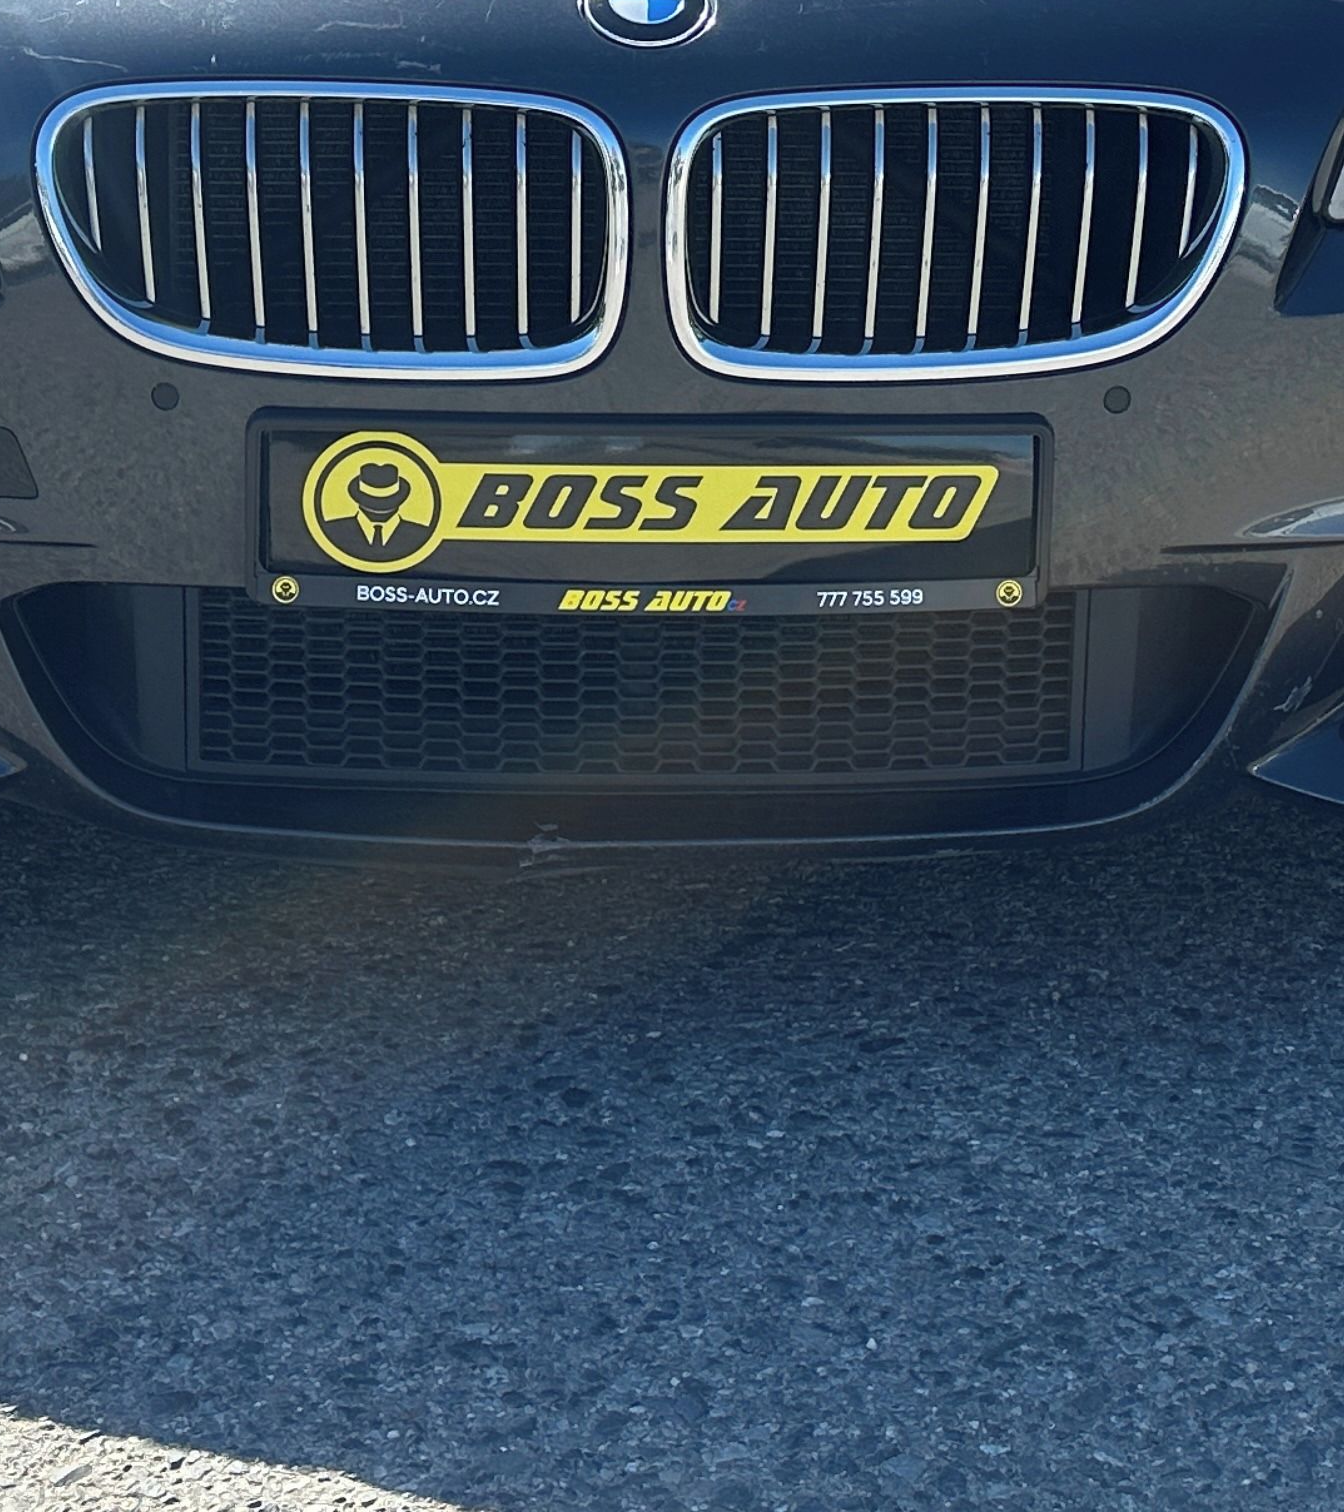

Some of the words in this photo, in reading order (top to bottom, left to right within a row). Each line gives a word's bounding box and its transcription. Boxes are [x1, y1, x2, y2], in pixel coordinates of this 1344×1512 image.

[456, 473, 704, 531] BOSS
[719, 474, 981, 531] AUTO
[356, 585, 500, 606] BOSS-AUTO.CZ
[557, 589, 640, 611] BOSS
[643, 590, 732, 612] AUTO
[816, 591, 848, 607] 777
[852, 590, 884, 607] 755
[889, 589, 924, 605] 599
